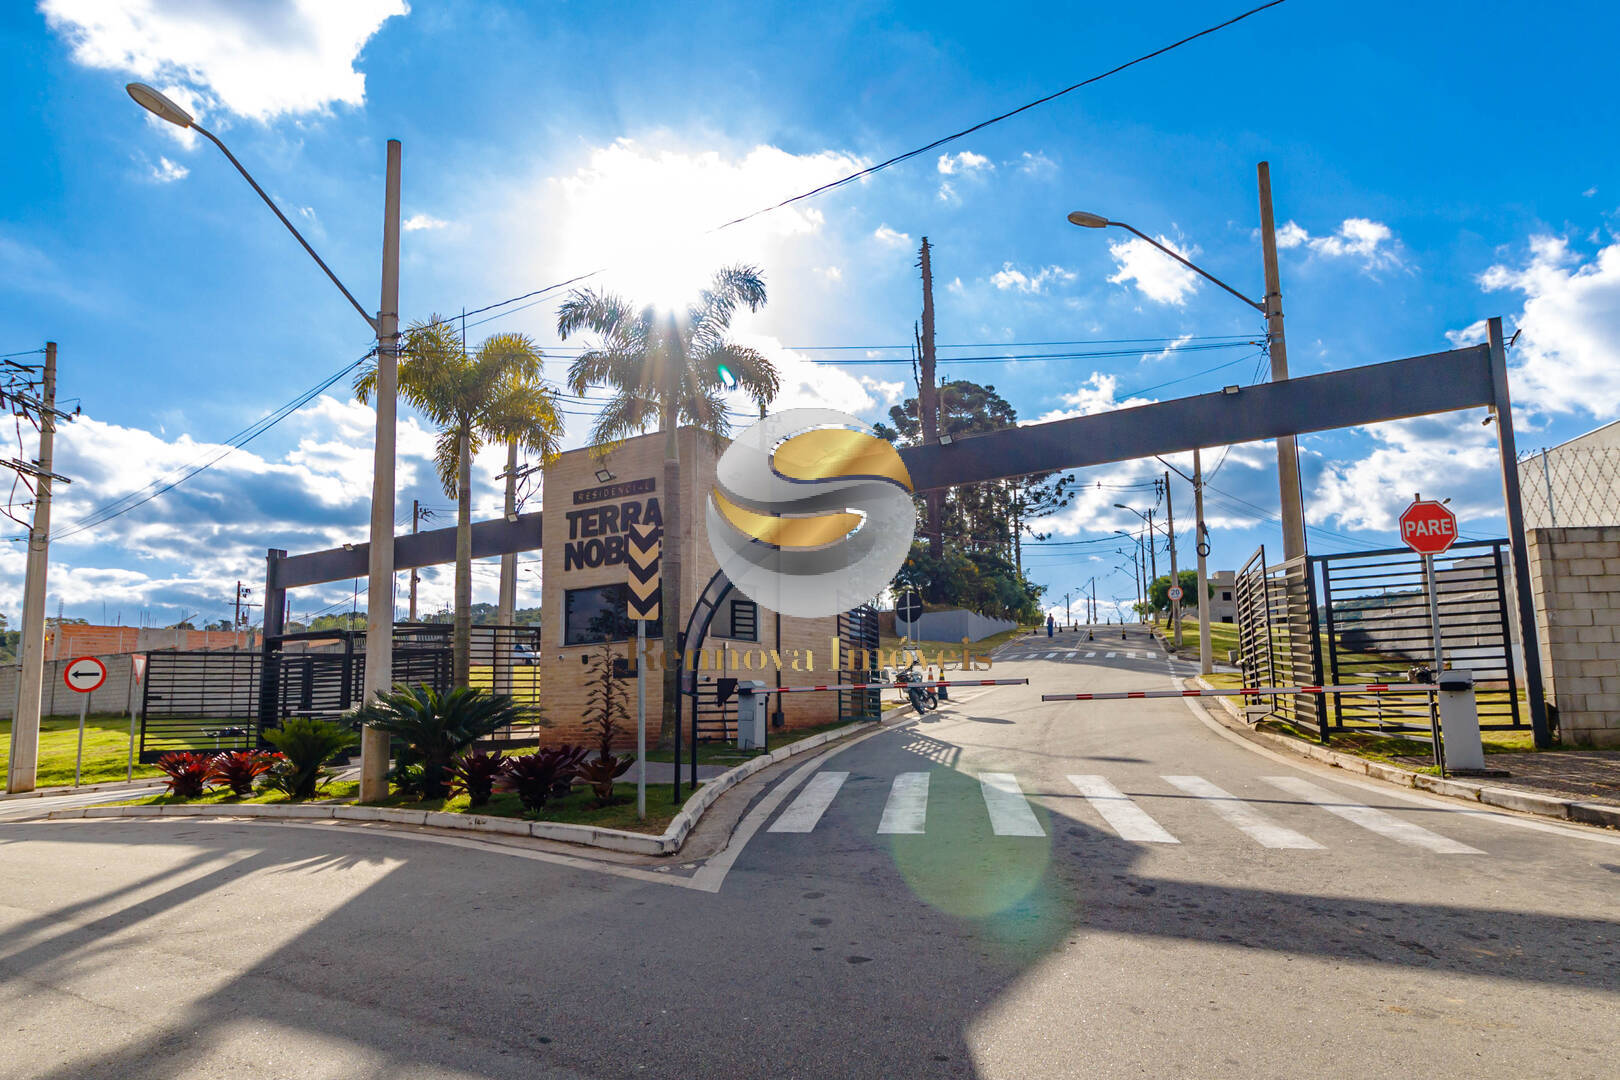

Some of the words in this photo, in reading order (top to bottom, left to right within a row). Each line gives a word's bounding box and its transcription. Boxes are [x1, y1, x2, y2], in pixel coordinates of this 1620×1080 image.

[566, 498, 664, 540] TERRA
[1405, 518, 1453, 537] PARE
[564, 529, 664, 571] NOB
